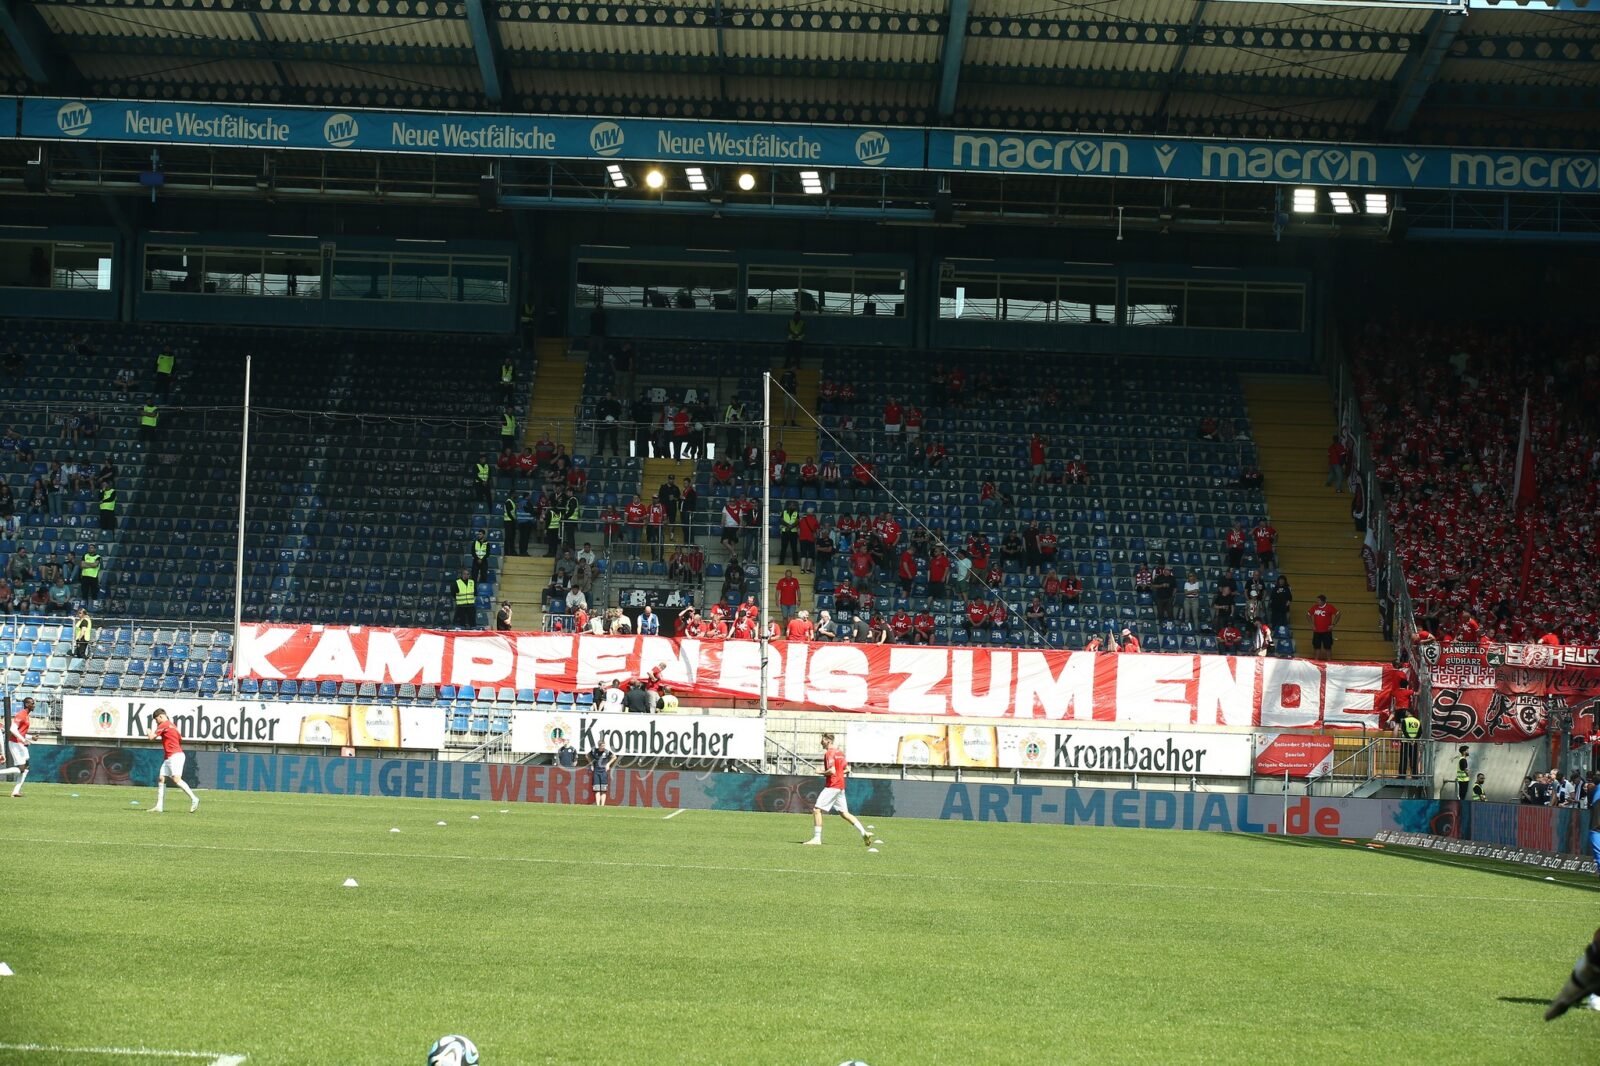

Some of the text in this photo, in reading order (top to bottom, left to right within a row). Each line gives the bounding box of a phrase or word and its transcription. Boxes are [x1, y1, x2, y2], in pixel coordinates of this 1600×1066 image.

[60, 108, 89, 129] NW
[126, 110, 290, 142] Neue Westfälische
[327, 119, 355, 141] NW
[392, 122, 556, 150] Neue Westfälische
[592, 127, 622, 148] NW
[658, 130, 821, 160] Neue Westfälische
[858, 136, 888, 159] NW
[953, 135, 1128, 173] macron
[1202, 145, 1377, 182] macron
[239, 622, 701, 692] KÄMPFEN
[1443, 647, 1486, 655] MANSFELD
[1446, 656, 1481, 665] SÜDHARZ
[718, 640, 869, 709] BIS
[888, 648, 1096, 720] ZUM
[1116, 652, 1384, 730] ENDE
[1519, 697, 1539, 705] HFC
[127, 702, 280, 741] Krmbacher
[579, 717, 734, 757] Krombacher
[1054, 732, 1208, 773] Krombacher
[217, 753, 681, 808] EINFACH GEILE WERBUNG
[940, 783, 1341, 836] ART-MEDIAL.de
